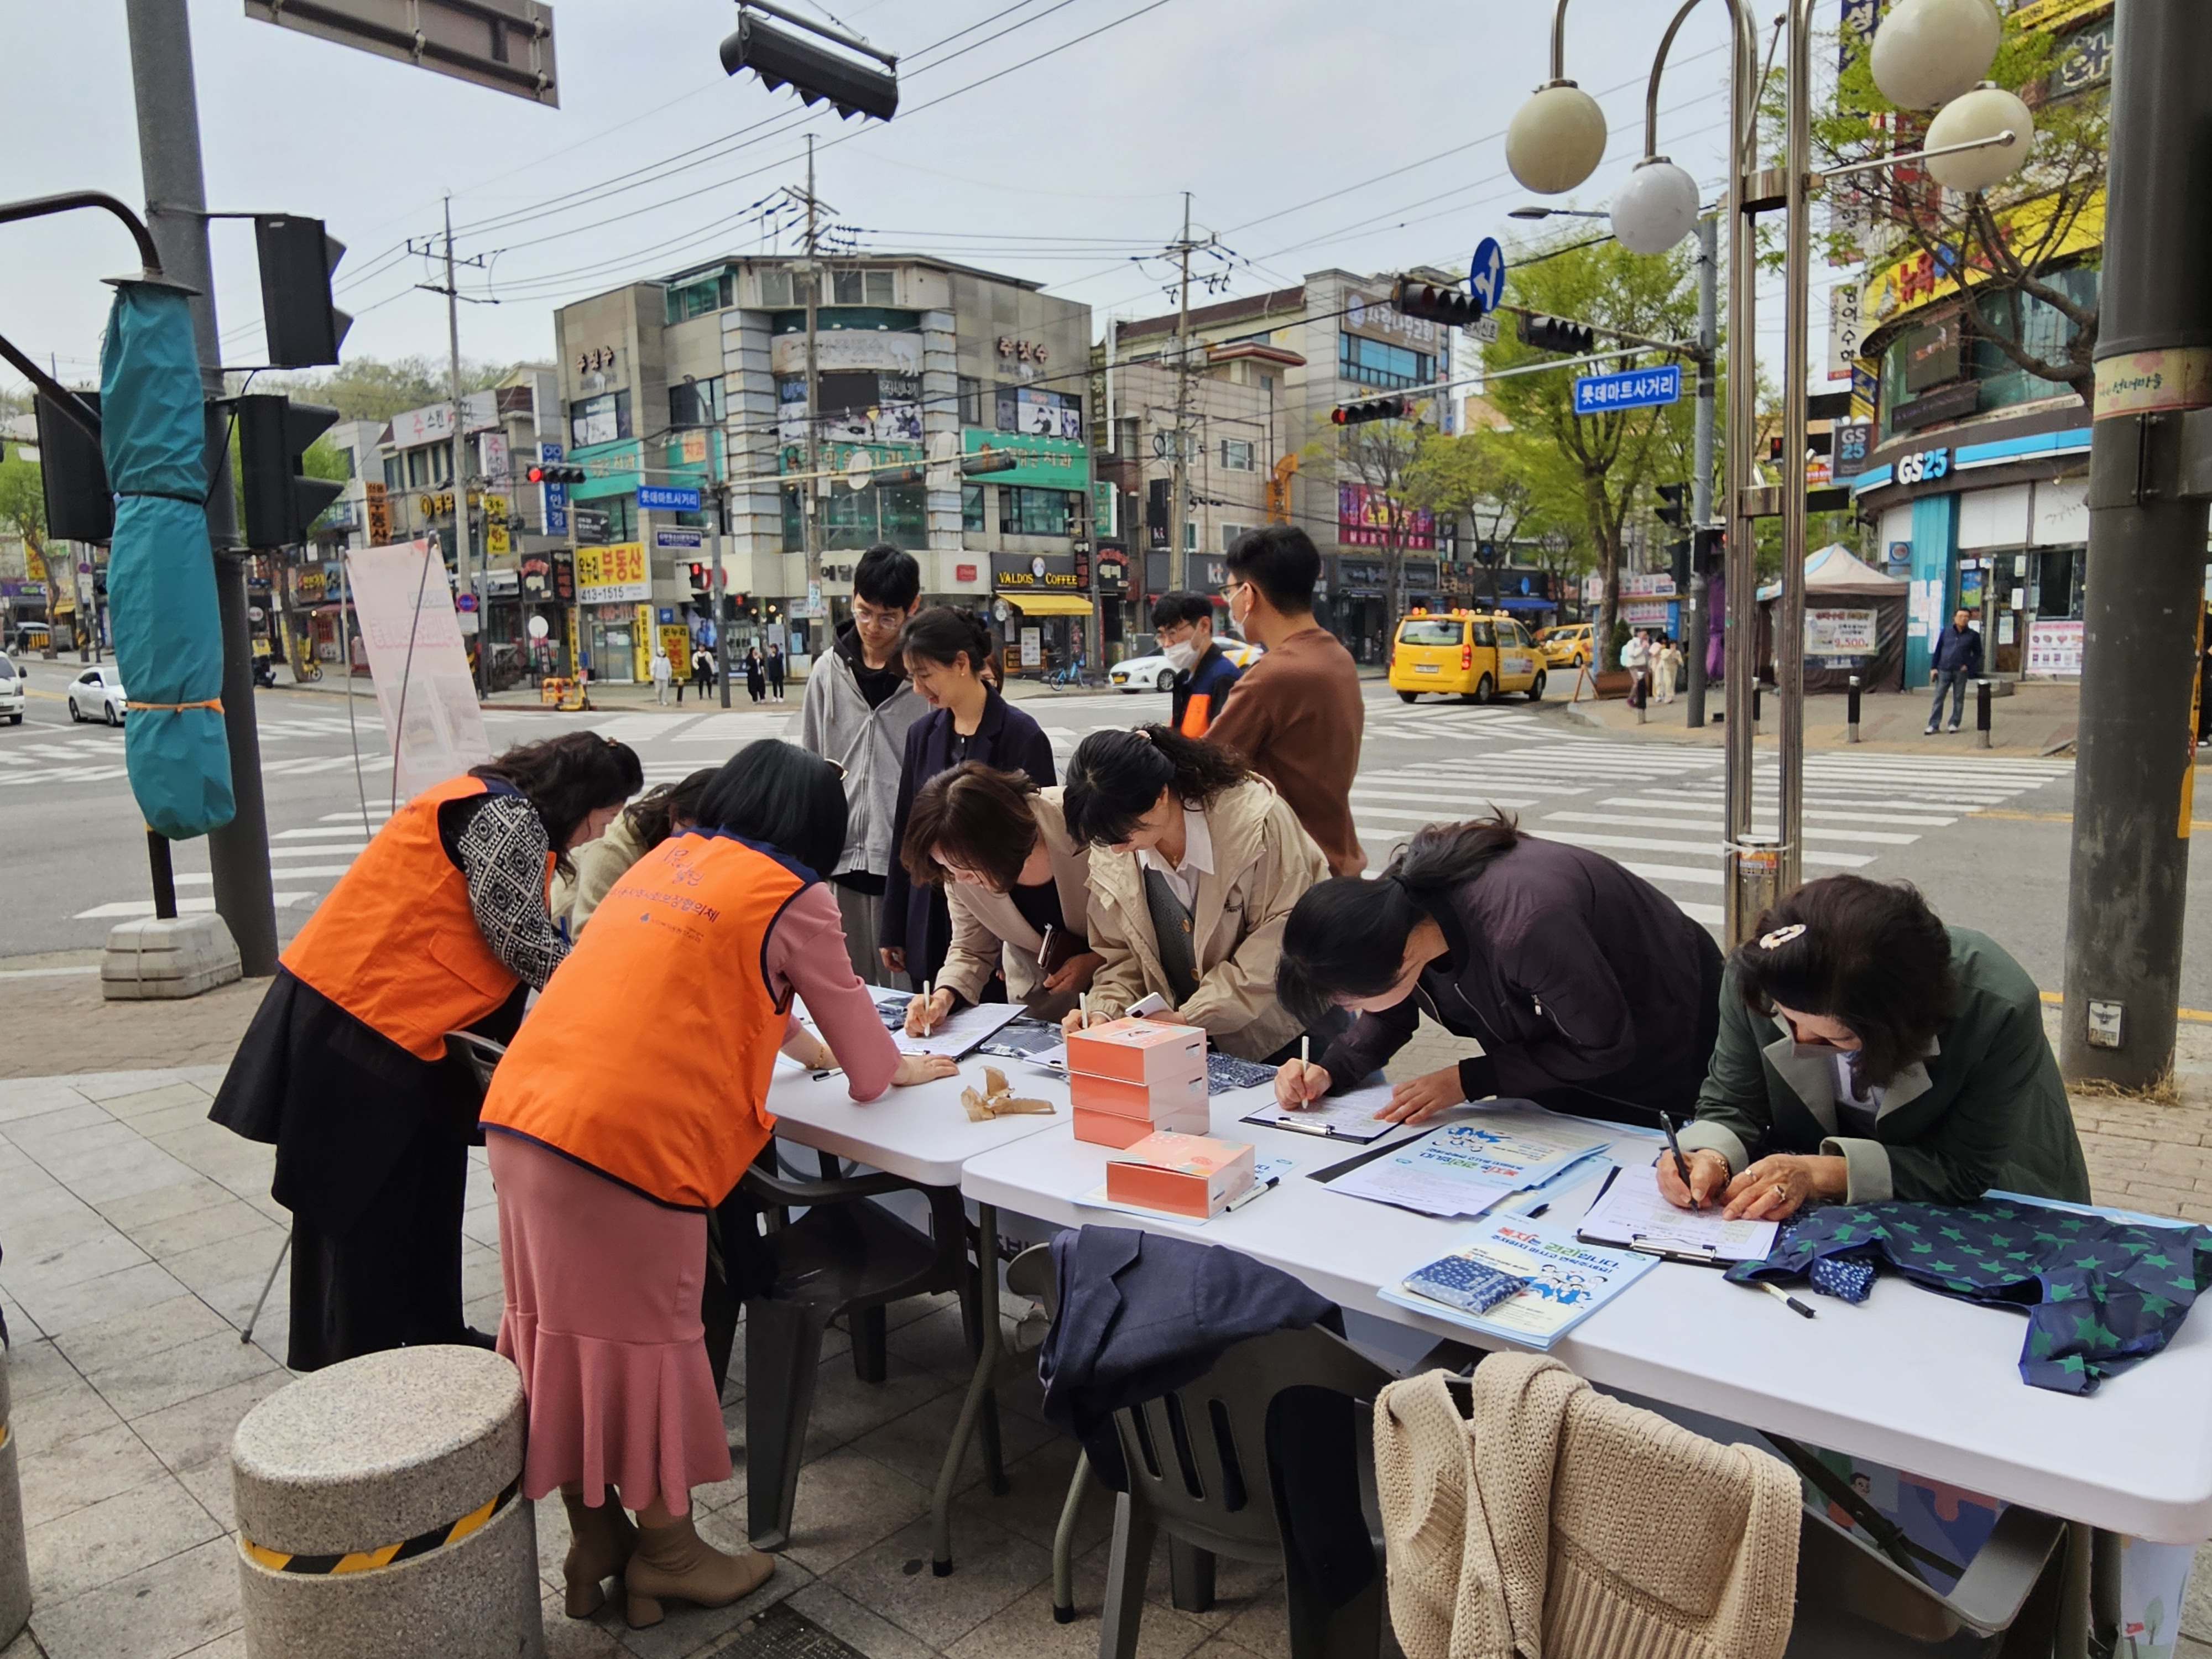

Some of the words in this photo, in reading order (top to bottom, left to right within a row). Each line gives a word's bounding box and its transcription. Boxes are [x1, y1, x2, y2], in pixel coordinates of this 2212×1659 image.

[1581, 373, 1674, 405] 롯데마트사거리
[1841, 428, 1867, 444] GS
[1841, 443, 1866, 460] 25
[1897, 447, 1948, 485] GS25
[641, 489, 697, 506] 롯데마트사거리
[602, 546, 642, 583] 부동산
[999, 572, 1034, 585] VALDOS
[1045, 572, 1078, 585] COFFEE
[581, 586, 624, 601] 413-1515
[1491, 1234, 1528, 1251] 주저하지
[1529, 1245, 1557, 1260] 마시고
[1497, 1227, 1542, 1245] 복지는
[1545, 1242, 1620, 1270] 권리입니다.
